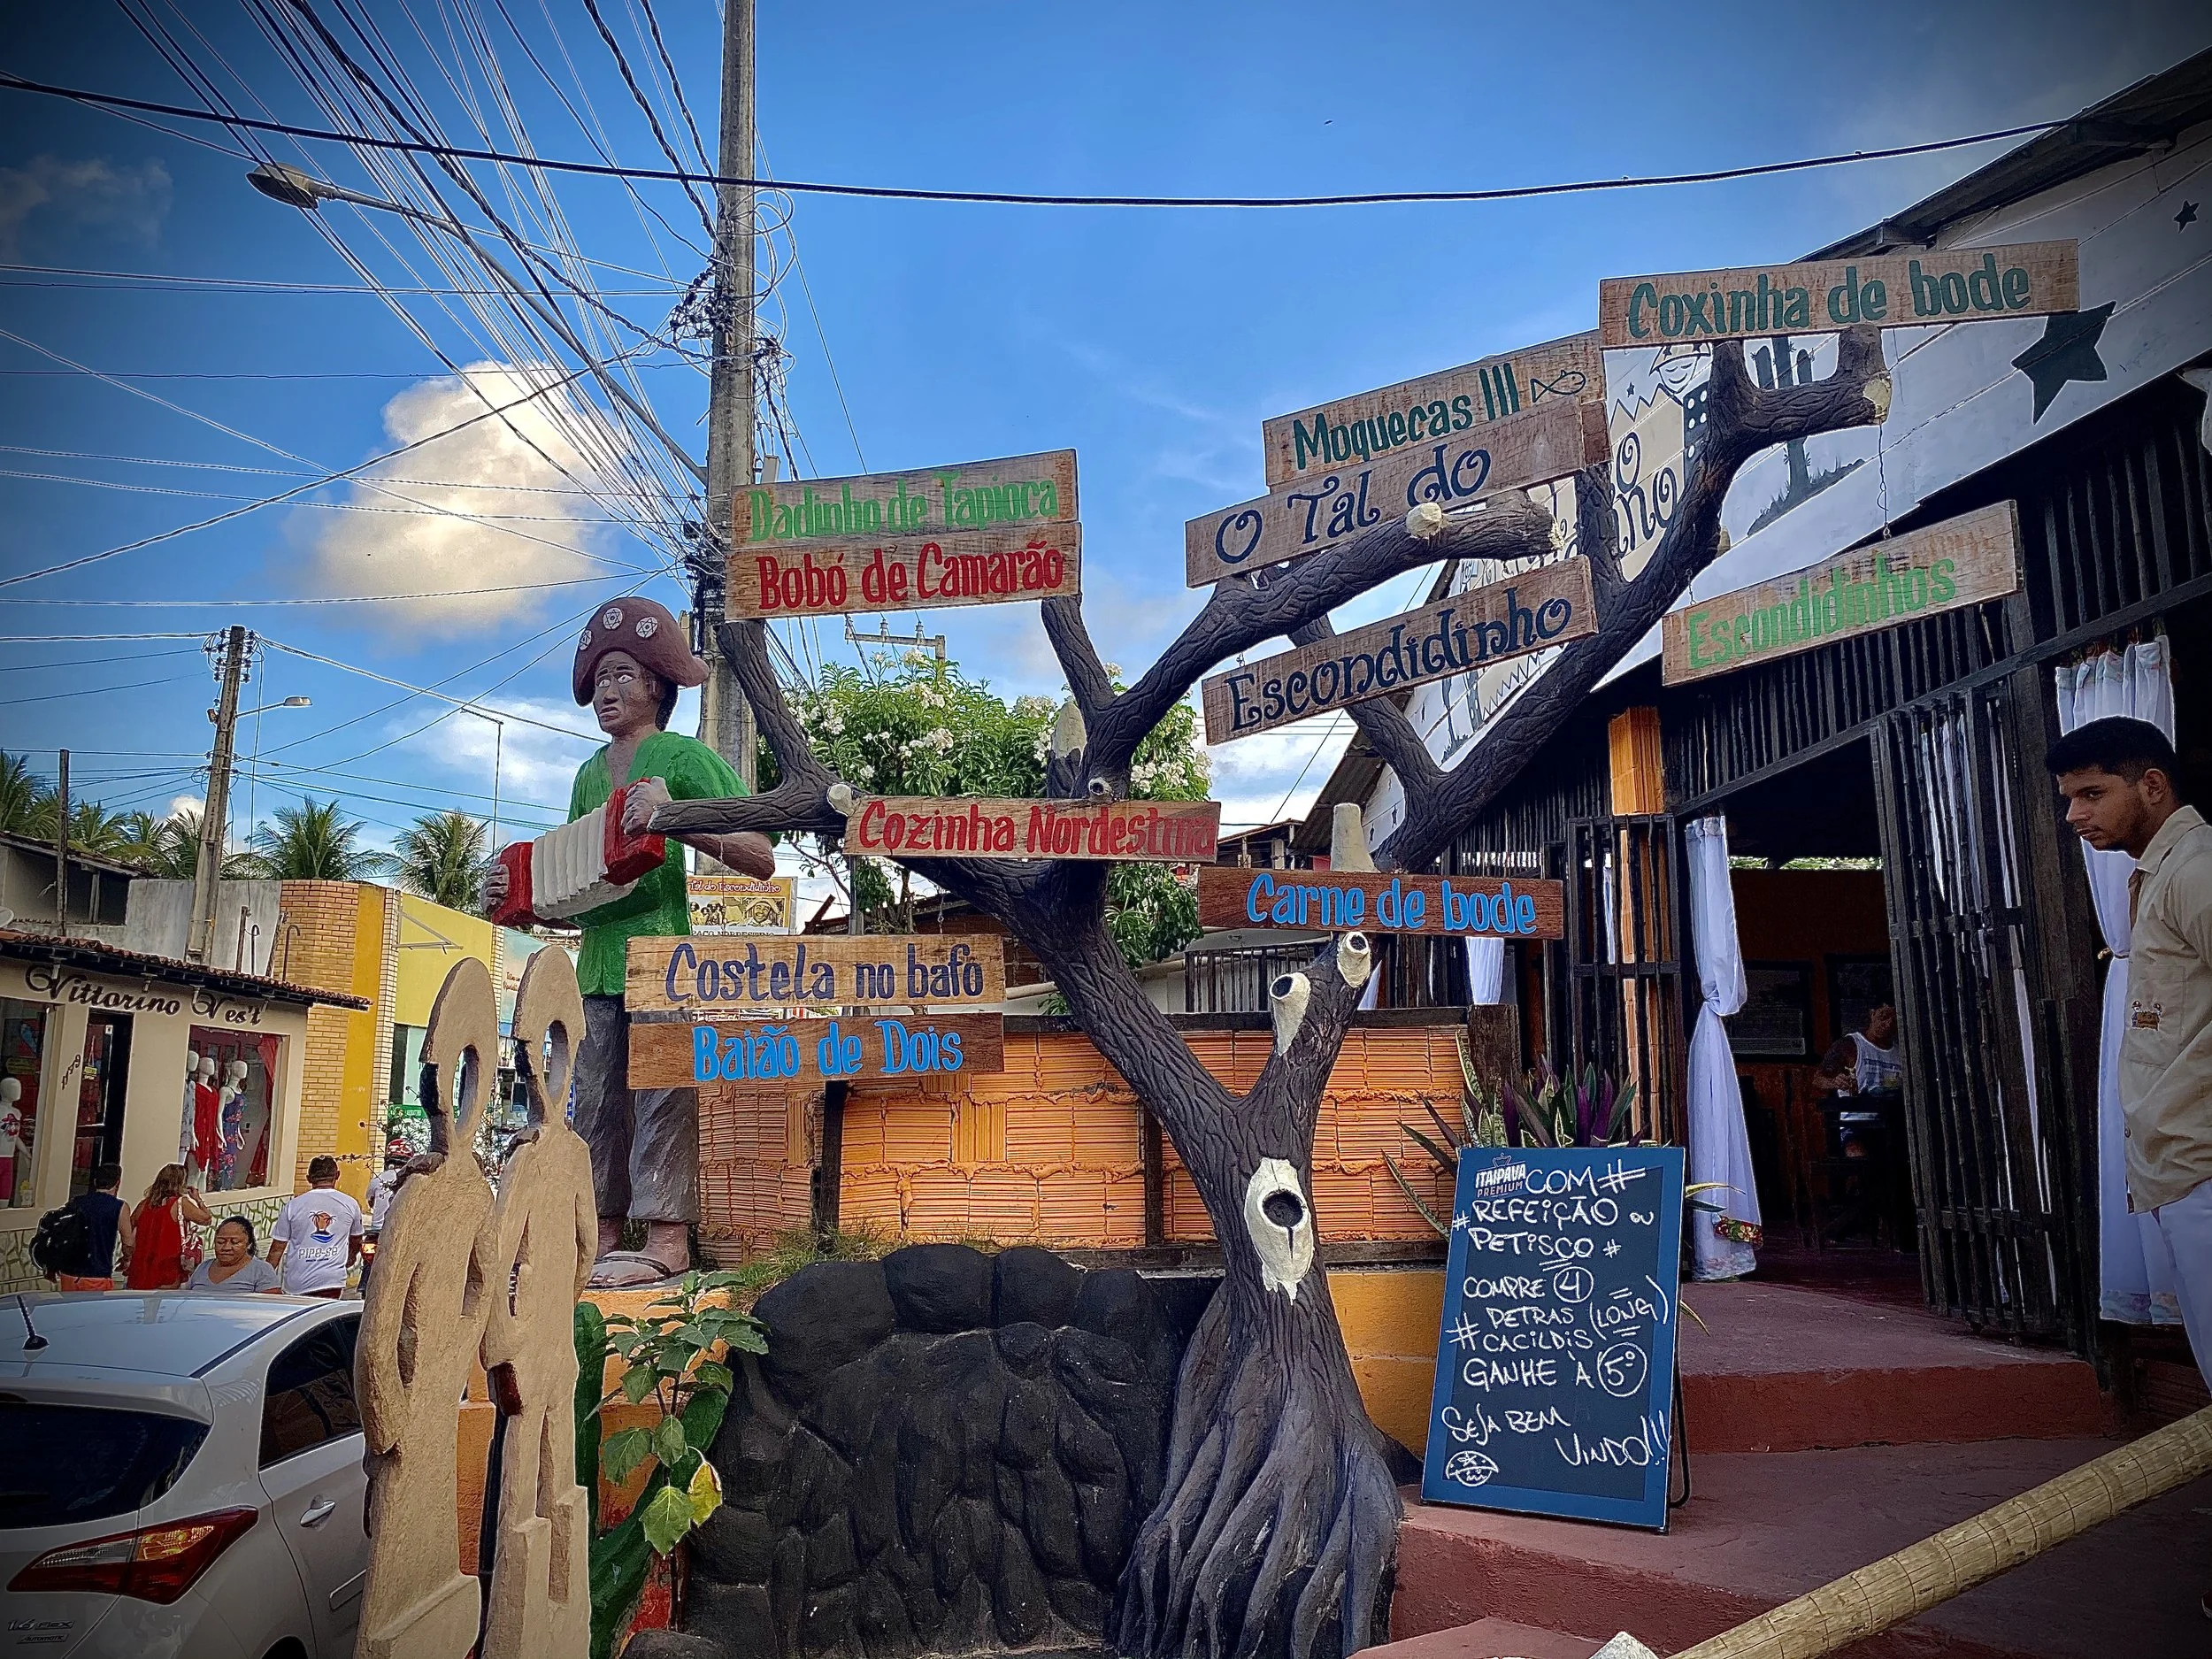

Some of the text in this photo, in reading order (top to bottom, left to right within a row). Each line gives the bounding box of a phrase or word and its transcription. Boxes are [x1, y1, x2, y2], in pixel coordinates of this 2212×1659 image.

[1627, 253, 2032, 339] Coxinha de bode
[1293, 395, 1472, 470] Moquecas
[747, 470, 1059, 542] Dadinho de Tapioca
[1215, 443, 1491, 565] O Tal do
[755, 540, 1064, 611] Bobó de Camarão
[1687, 552, 1956, 670] Escondidinhos
[1224, 588, 1572, 732] Escondidinho
[858, 800, 1216, 856] Cozinha Nordestina
[1247, 872, 1537, 934] Carne de bode
[26, 964, 181, 1016] Vittorino
[664, 943, 984, 1002] Costela no bafo
[693, 1019, 964, 1081] Baião de Dois
[1476, 1164, 1526, 1188] ITAIPAVA
[1477, 1180, 1523, 1198] PREMIUM
[1526, 1166, 1598, 1196] COM
[1463, 1276, 1547, 1299] COMPRE
[1486, 1306, 1574, 1329] PETRAS
[1463, 1357, 1557, 1393] GANHE
[1441, 1403, 1571, 1446] SEJA BEM
